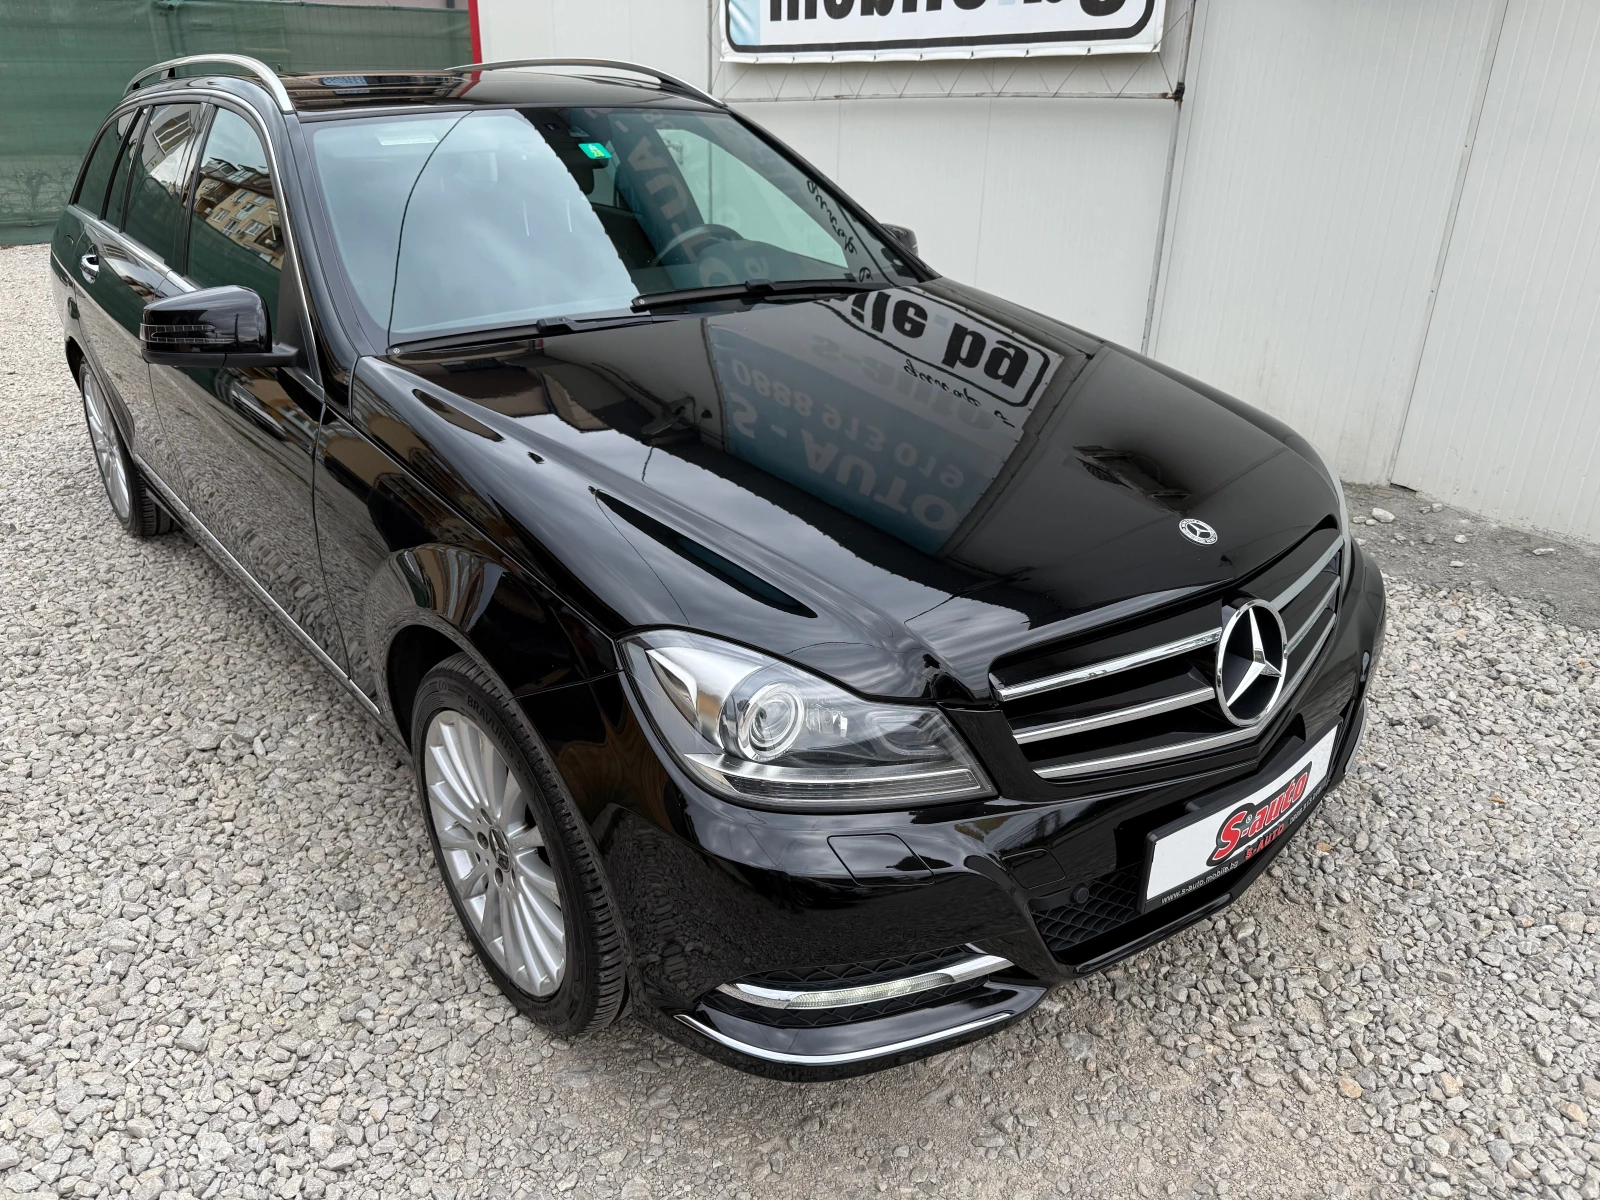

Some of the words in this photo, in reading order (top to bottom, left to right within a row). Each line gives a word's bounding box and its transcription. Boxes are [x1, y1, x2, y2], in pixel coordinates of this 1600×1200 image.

[467, 695, 515, 759] BRAVURIS
[1212, 772, 1307, 860] S-auto
[1161, 860, 1239, 904] www.s-auto.mobile.bg
[1245, 823, 1285, 861] S-AUTO
